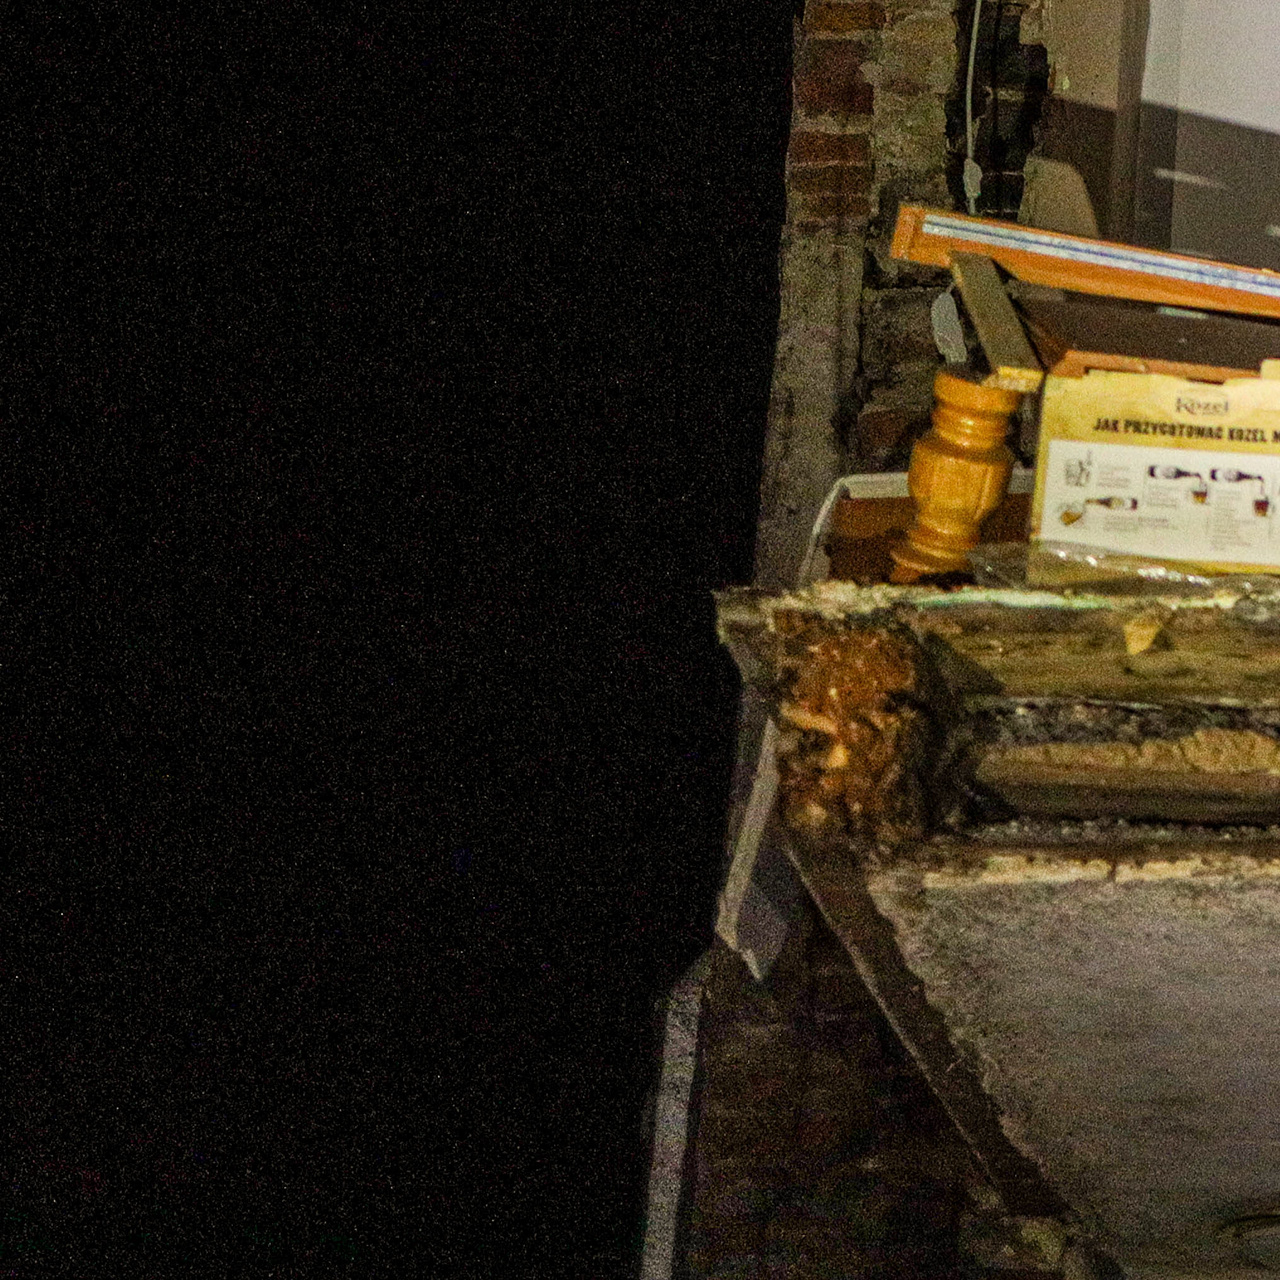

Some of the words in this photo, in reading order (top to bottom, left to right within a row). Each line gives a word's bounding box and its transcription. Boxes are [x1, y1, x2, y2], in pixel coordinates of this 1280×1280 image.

[1176, 397, 1229, 416] Kozel
[1093, 418, 1119, 433] JAK
[1228, 428, 1267, 443] KOZEL
